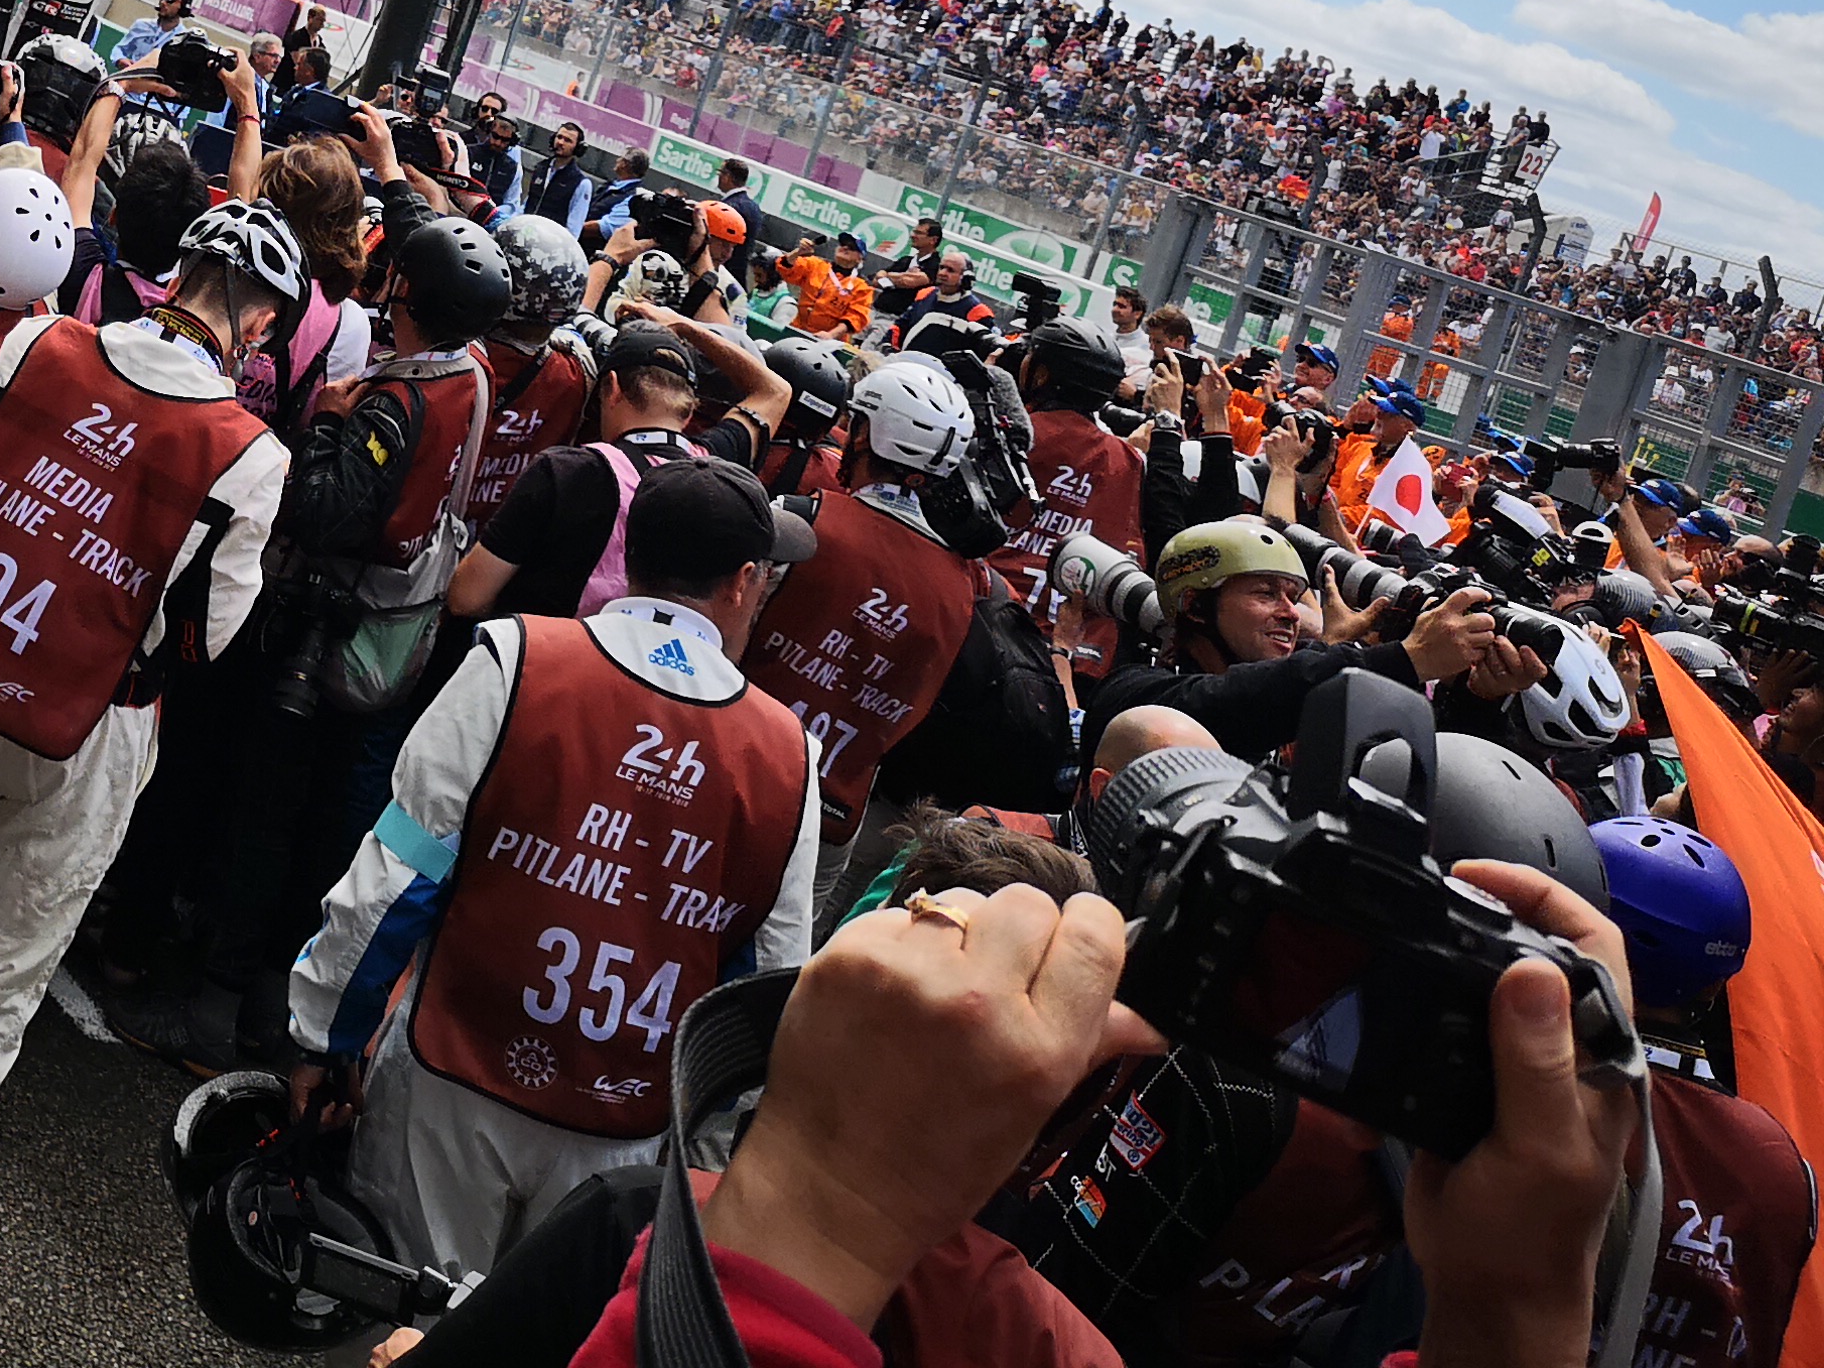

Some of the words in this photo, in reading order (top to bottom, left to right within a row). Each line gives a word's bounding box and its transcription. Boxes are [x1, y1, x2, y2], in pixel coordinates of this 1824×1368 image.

[658, 139, 714, 182] Sarthe
[1521, 152, 1543, 176] 22
[788, 186, 852, 231] Sarthe
[905, 193, 986, 241] Sathe
[71, 403, 138, 456] 24h
[496, 409, 543, 435] 24h
[63, 429, 82, 445] LE
[80, 438, 123, 467] MANS
[24, 455, 114, 524] MEDIA
[1050, 465, 1092, 497] 24h
[69, 528, 153, 598] TRACK
[1004, 531, 1057, 558] LANE
[859, 588, 908, 632] 24h
[1023, 567, 1068, 625] 7
[852, 609, 866, 620] LE
[866, 617, 897, 640] MANS
[648, 650, 695, 677] adidas
[819, 629, 854, 660] RH
[863, 653, 894, 681] TV
[764, 631, 844, 692] PITLANE
[851, 683, 914, 724] TRACK
[622, 723, 705, 786] 24h
[616, 765, 638, 781] LE
[637, 773, 694, 800] MANS
[577, 803, 633, 852] RH
[660, 828, 713, 875] TV
[486, 827, 632, 908] PITLANE
[661, 883, 746, 934] TRAK
[1704, 941, 1738, 957] etto
[522, 927, 682, 1053] 354
[593, 1075, 651, 1097] WEC
